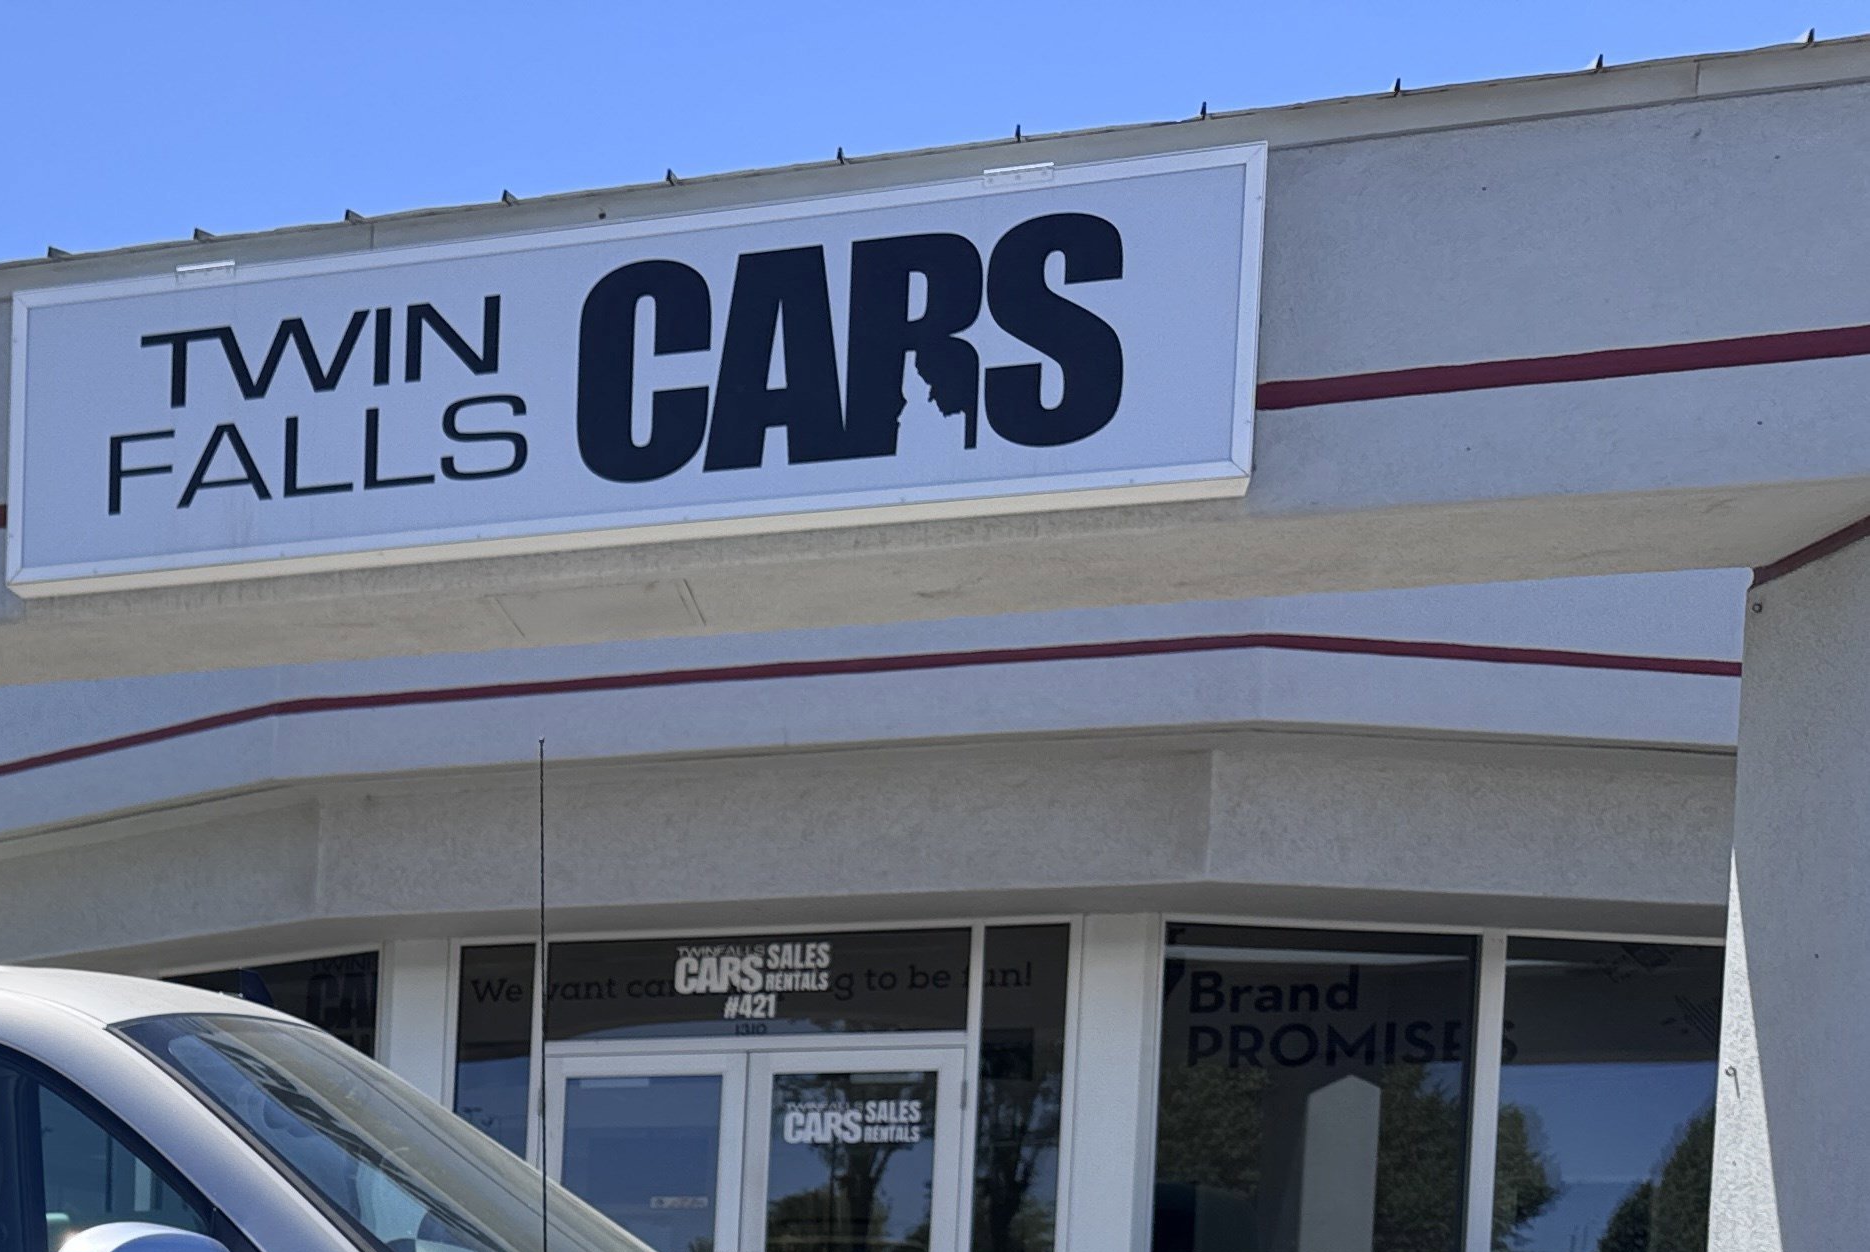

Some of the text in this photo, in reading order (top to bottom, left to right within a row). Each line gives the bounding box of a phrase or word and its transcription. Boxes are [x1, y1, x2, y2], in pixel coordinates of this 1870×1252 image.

[140, 293, 502, 410] TWIN
[576, 212, 1125, 484] CARS
[107, 393, 529, 517] FALLS
[766, 942, 831, 970] SALES
[471, 977, 523, 1002] We
[864, 968, 898, 991] to
[908, 964, 952, 990] be
[674, 955, 765, 995] CARS
[764, 971, 829, 992] RENTALS
[1188, 963, 1360, 1014] Brand
[723, 993, 777, 1020] #421
[783, 1110, 863, 1145] CARS
[864, 1100, 922, 1124] SALES
[863, 1125, 921, 1143] RENTALS
